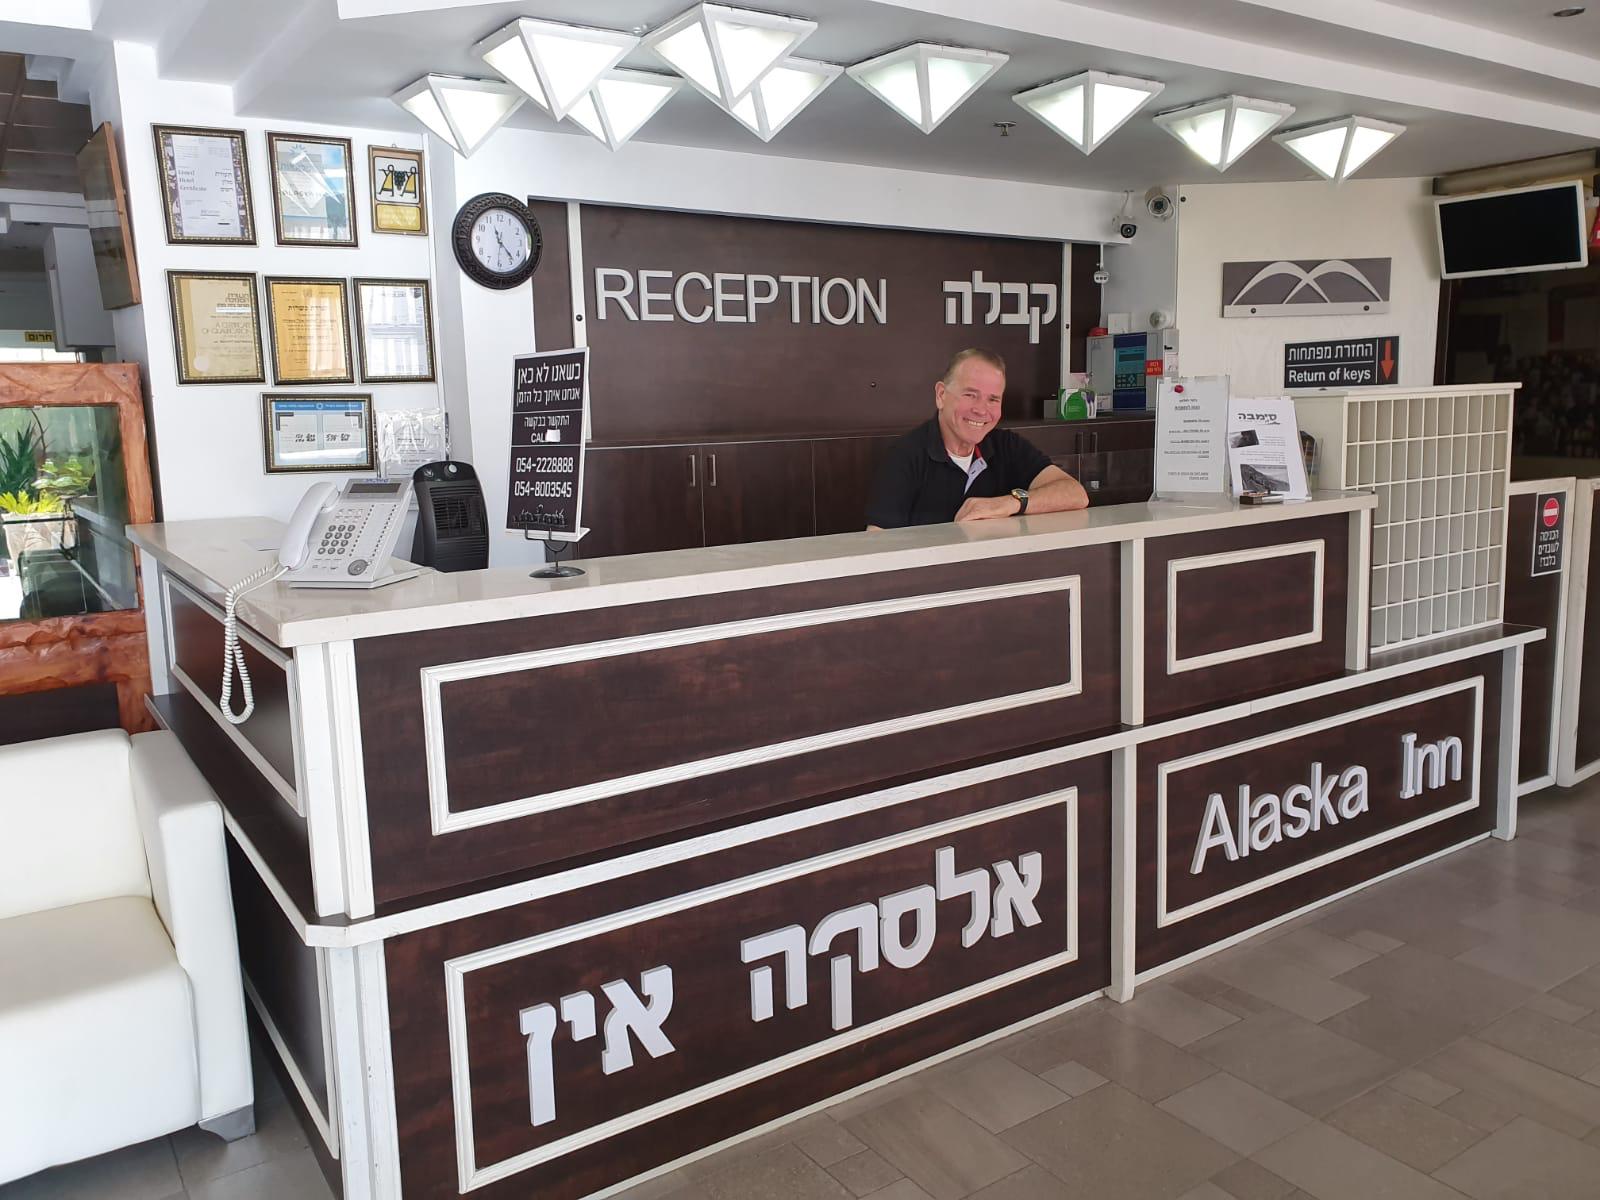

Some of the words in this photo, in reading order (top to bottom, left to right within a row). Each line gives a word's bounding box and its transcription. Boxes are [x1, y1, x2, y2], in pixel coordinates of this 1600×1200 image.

[595, 267, 887, 325] RECEPTION
[942, 270, 1057, 344] קבלה
[1288, 346, 1332, 361] מפתחות
[1334, 343, 1373, 358] החזרת
[517, 367, 534, 390] כאן
[535, 362, 550, 383] לא
[551, 363, 581, 382] כשאנו
[1288, 369, 1326, 382] Return
[1328, 367, 1341, 381] of
[1343, 367, 1371, 383] keys
[516, 391, 532, 407] הזמן
[532, 388, 542, 403] כל
[561, 387, 581, 401] אנחנו
[1238, 412, 1277, 421] סימבה
[530, 432, 548, 443] CAL
[516, 457, 574, 473] 054-2228888
[514, 481, 572, 498] 054-8003545
[1190, 761, 1369, 875] Alaska
[1400, 732, 1463, 800] Inn
[740, 845, 1043, 1031] אלסקה
[519, 964, 676, 1128] אין
